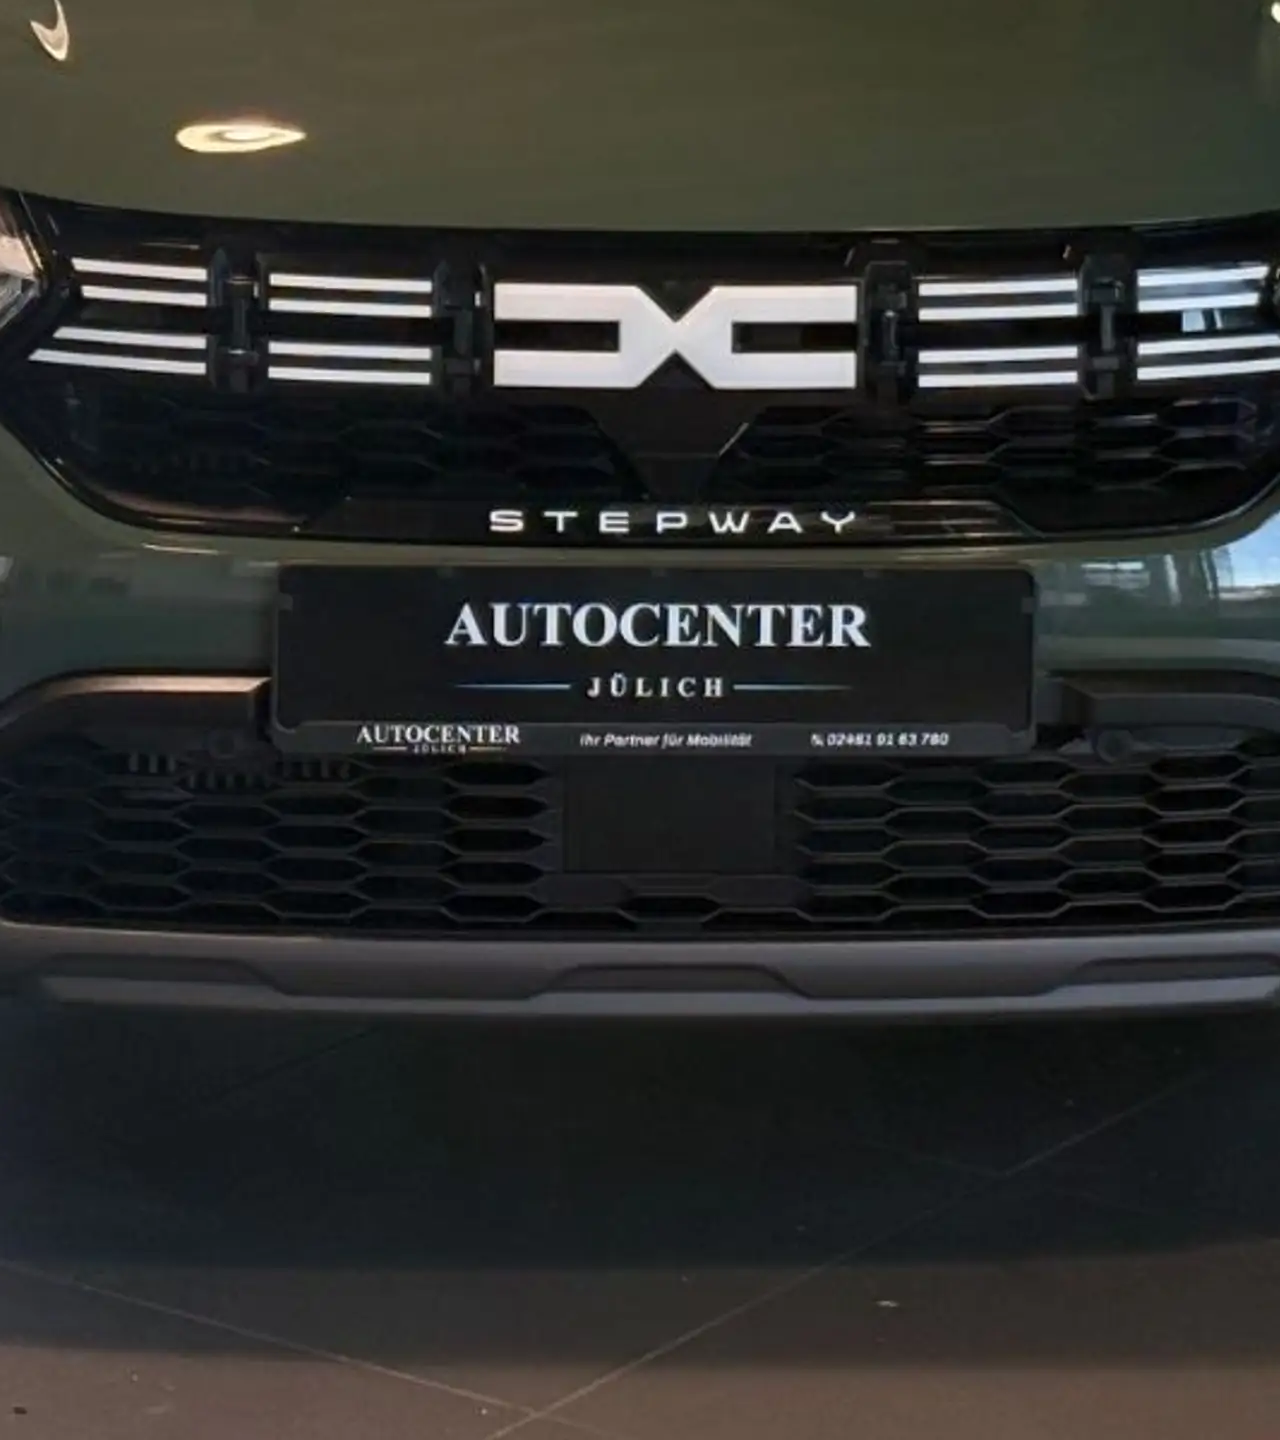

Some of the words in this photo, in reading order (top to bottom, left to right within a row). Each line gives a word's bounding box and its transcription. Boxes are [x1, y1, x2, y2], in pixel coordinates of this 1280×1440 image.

[488, 510, 857, 533] STEPWAY
[444, 602, 872, 648] AUTOCENTER
[586, 673, 724, 699] JÜLICH
[356, 724, 521, 744] AUTOCENTER
[603, 732, 661, 747] Partner
[660, 732, 685, 749] für
